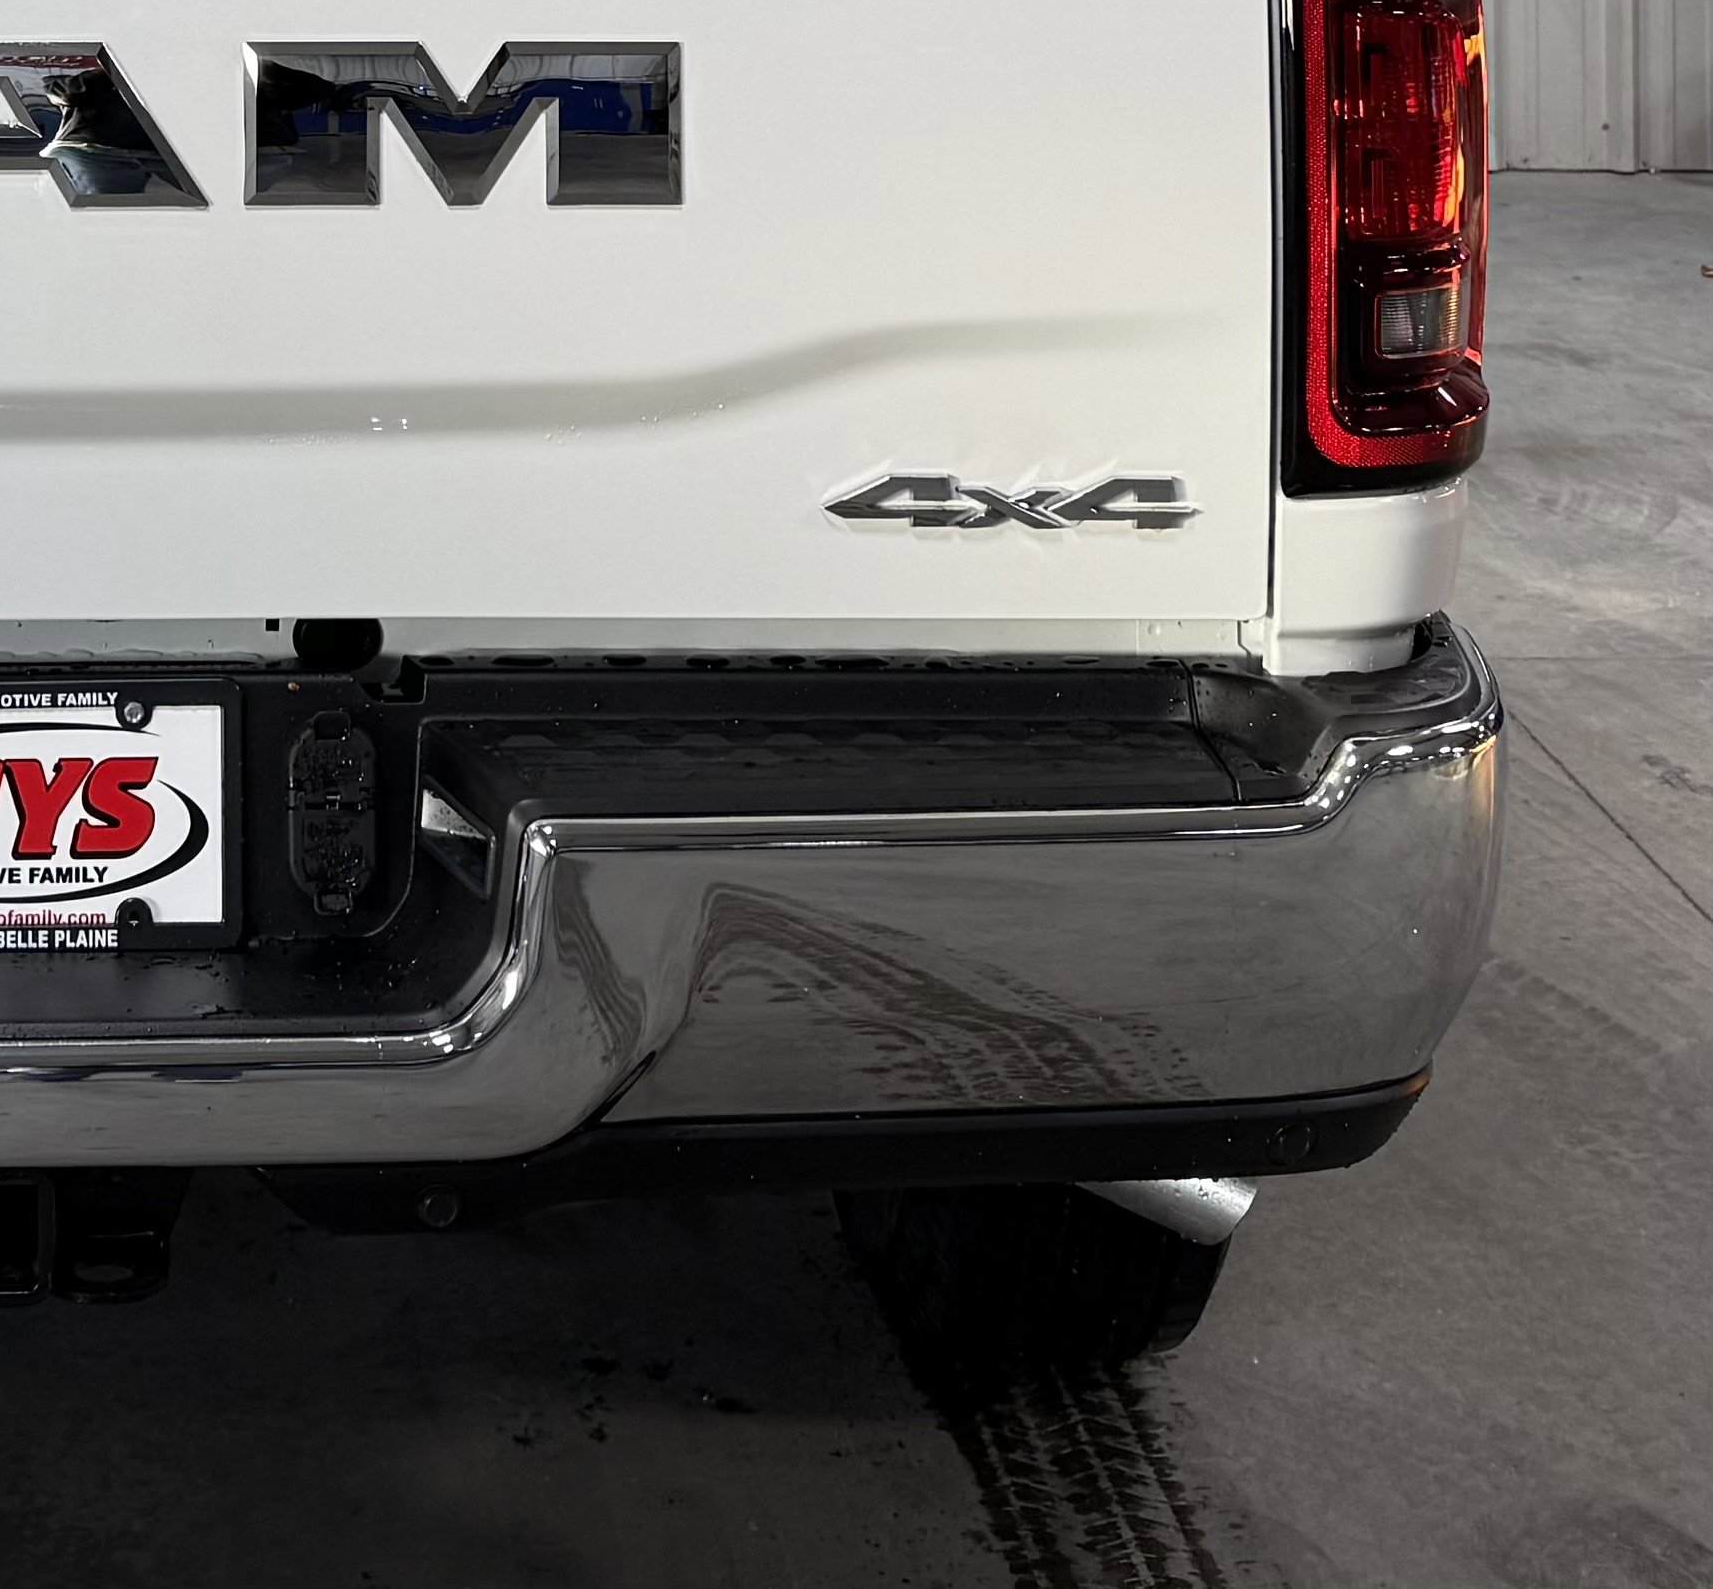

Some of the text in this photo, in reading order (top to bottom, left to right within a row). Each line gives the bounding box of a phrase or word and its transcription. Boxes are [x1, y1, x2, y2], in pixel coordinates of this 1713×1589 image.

[57, 691, 119, 707] FAMILY
[28, 866, 108, 886] FAMILY
[54, 929, 119, 948] PLAINE
